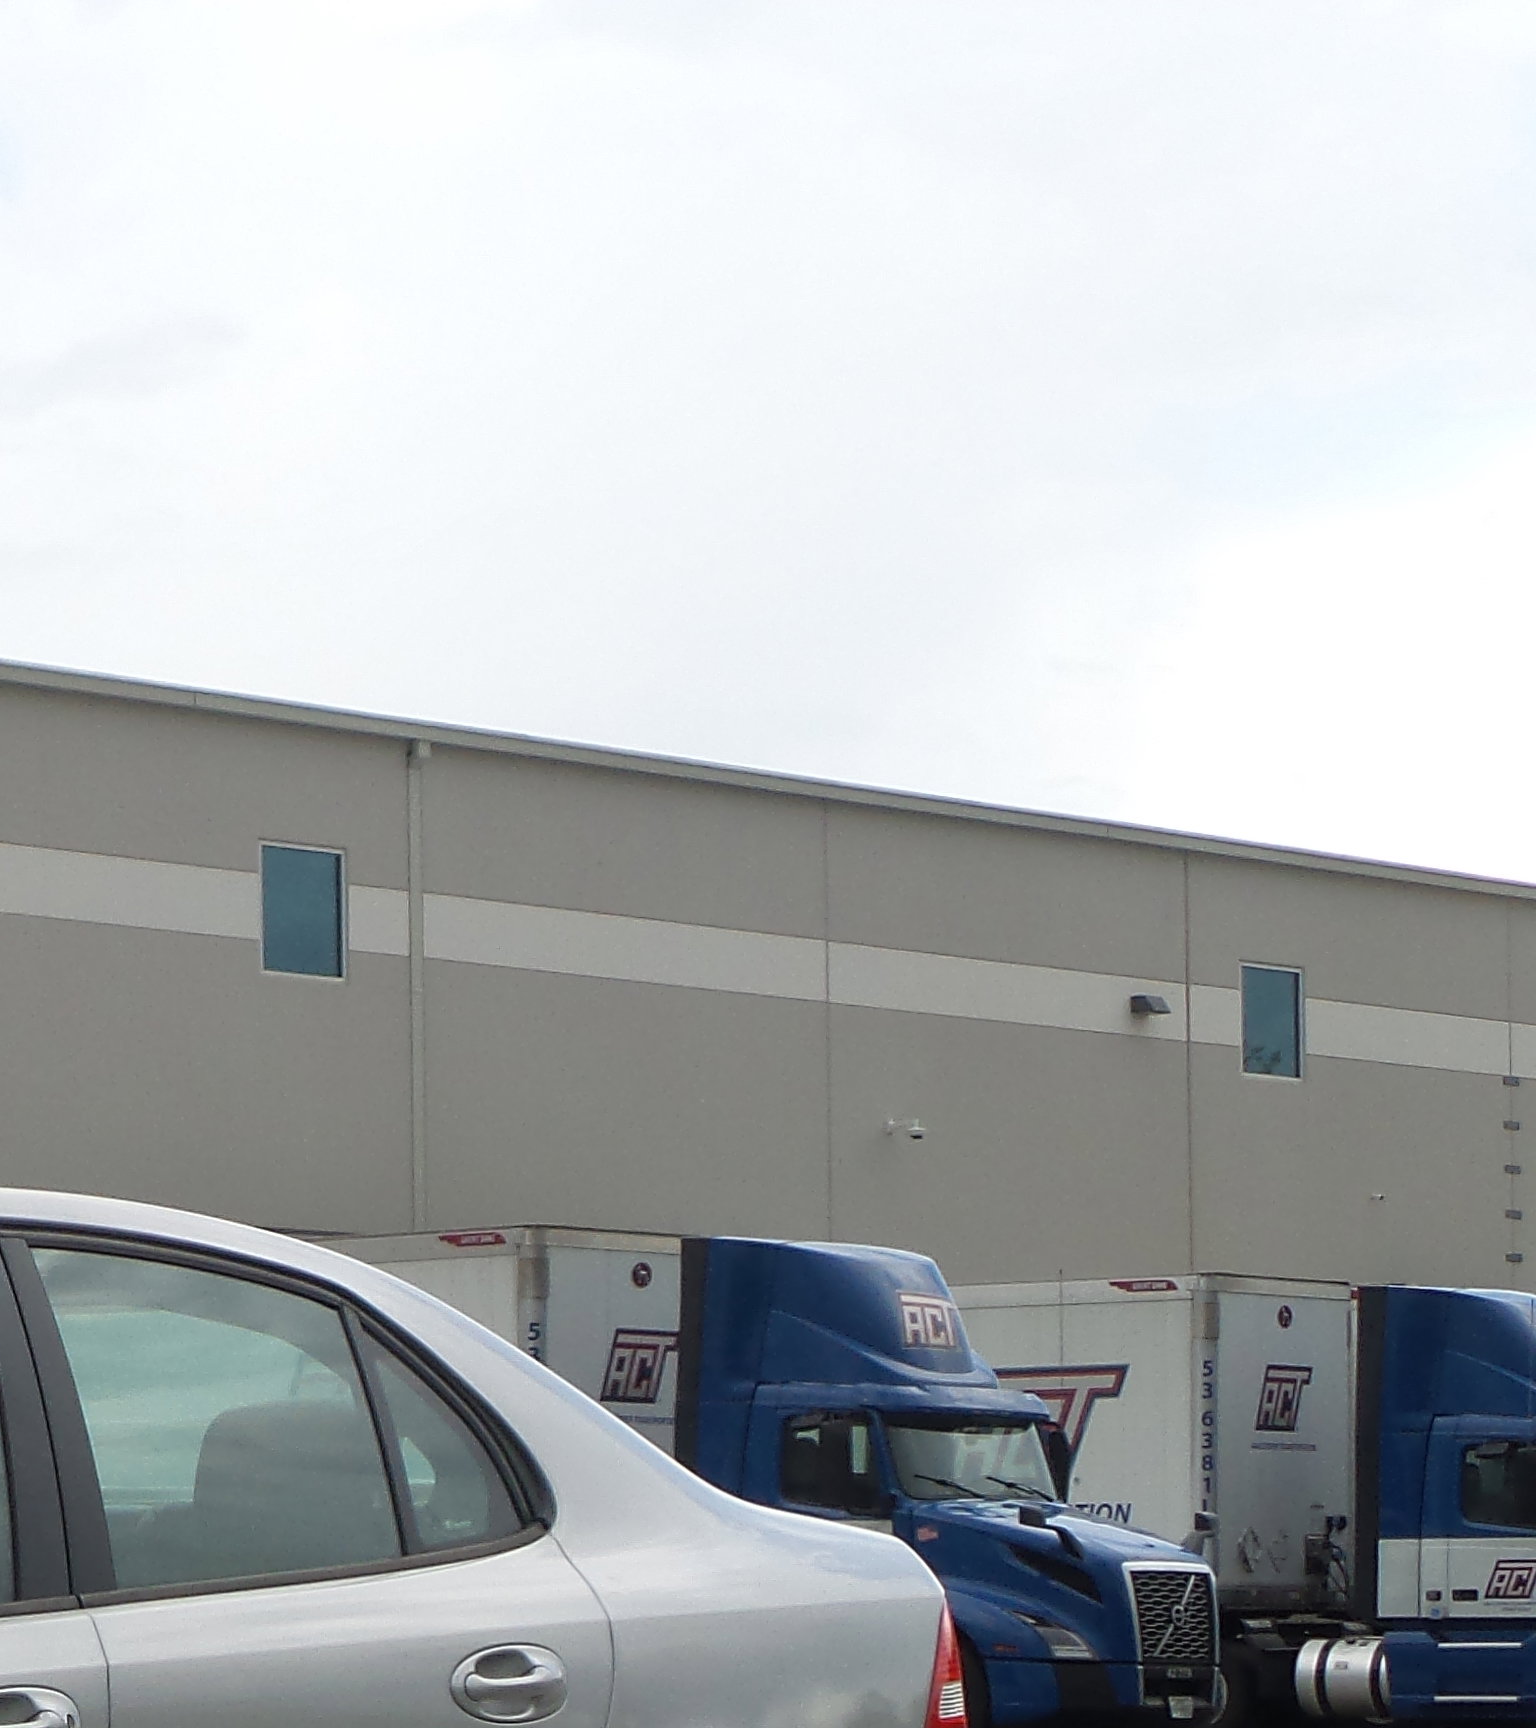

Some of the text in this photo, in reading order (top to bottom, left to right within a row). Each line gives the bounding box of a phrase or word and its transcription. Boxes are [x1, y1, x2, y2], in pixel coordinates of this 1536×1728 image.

[897, 1291, 961, 1349] ACT
[600, 1327, 679, 1404] ACT
[1255, 1363, 1314, 1432] ACT
